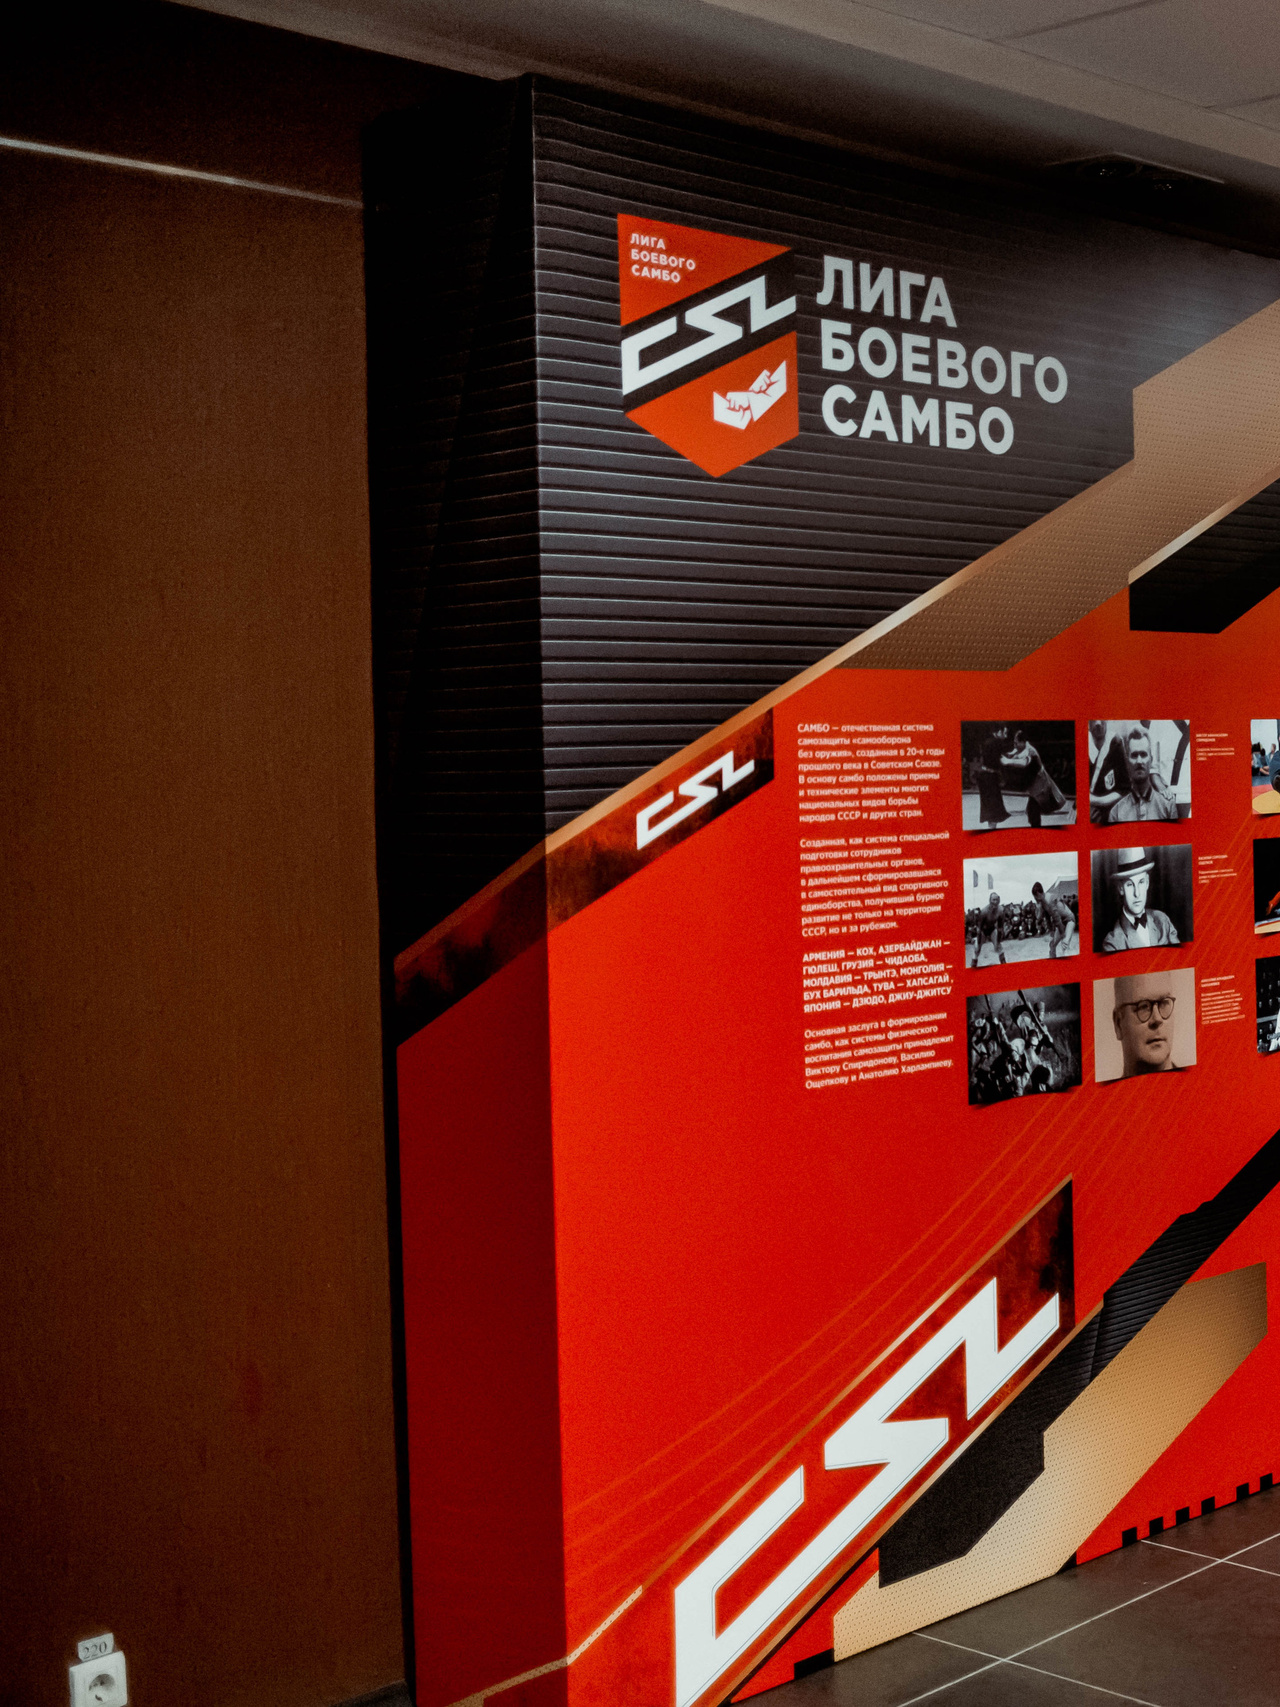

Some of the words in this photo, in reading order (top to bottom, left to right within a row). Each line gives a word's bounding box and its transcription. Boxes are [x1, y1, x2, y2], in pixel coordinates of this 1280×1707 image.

[630, 233, 666, 250] ЛИГА
[631, 249, 696, 271] БОЕВОГО
[631, 264, 681, 283] САМБО
[816, 254, 957, 328] ЛИГА
[820, 319, 1068, 404] БОЕВОГО
[821, 383, 1015, 455] САМБО
[798, 724, 830, 733] САМБО
[798, 738, 850, 746] самозащиты
[798, 749, 813, 758] без
[907, 747, 924, 756] 20-е
[799, 763, 841, 772] прошлого
[871, 761, 913, 769] Советском
[807, 776, 837, 784] основу
[839, 774, 865, 783] самбо
[866, 774, 908, 782] положены
[807, 788, 859, 796] технические
[799, 801, 860, 810] национальных
[862, 799, 887, 807] видов
[888, 797, 919, 806] борьбы
[800, 814, 836, 823] народов
[838, 811, 861, 821] СССР
[870, 812, 897, 820] других
[865, 836, 898, 844] система
[899, 831, 950, 842] специальной
[800, 851, 849, 861] подготовки
[850, 848, 902, 858] сотрудников
[801, 861, 888, 875] правоохранительных
[808, 875, 861, 887] дальнейшем
[862, 869, 942, 882] сформировавшаяся
[808, 885, 881, 898] самостоятельный
[900, 881, 949, 891] спортивного
[865, 894, 915, 906] получивший
[916, 893, 944, 903] бурное
[802, 915, 840, 926] развитие
[855, 911, 882, 919] только
[896, 906, 941, 916] территории
[850, 925, 858, 933] за
[803, 950, 845, 962] АРМЕНИЯ
[879, 940, 942, 954] АЗЕРБАЙДЖАН
[842, 959, 874, 970] ГРУЗИЯ
[803, 974, 852, 988] МОЛДАВИЯ
[900, 963, 945, 976] МОНГОЛИЯ
[804, 991, 821, 1001] БУХ
[873, 982, 895, 992] ТУВА
[804, 1000, 841, 1013] ЯПОНИЯ
[889, 987, 952, 1003] ДЖИУ-ДЖИТСУ
[804, 1027, 846, 1039] Основная
[848, 1022, 879, 1032] заслуга
[887, 1013, 947, 1028] формировании
[835, 1039, 849, 1047] как
[851, 1034, 886, 1044] системы
[887, 1026, 938, 1040] физического
[854, 1044, 902, 1057] самозащиты
[805, 1066, 841, 1077] Виктору
[901, 1050, 935, 1062] Василию
[859, 1068, 899, 1080] Анатолию
[83, 1641, 108, 1659] 220
